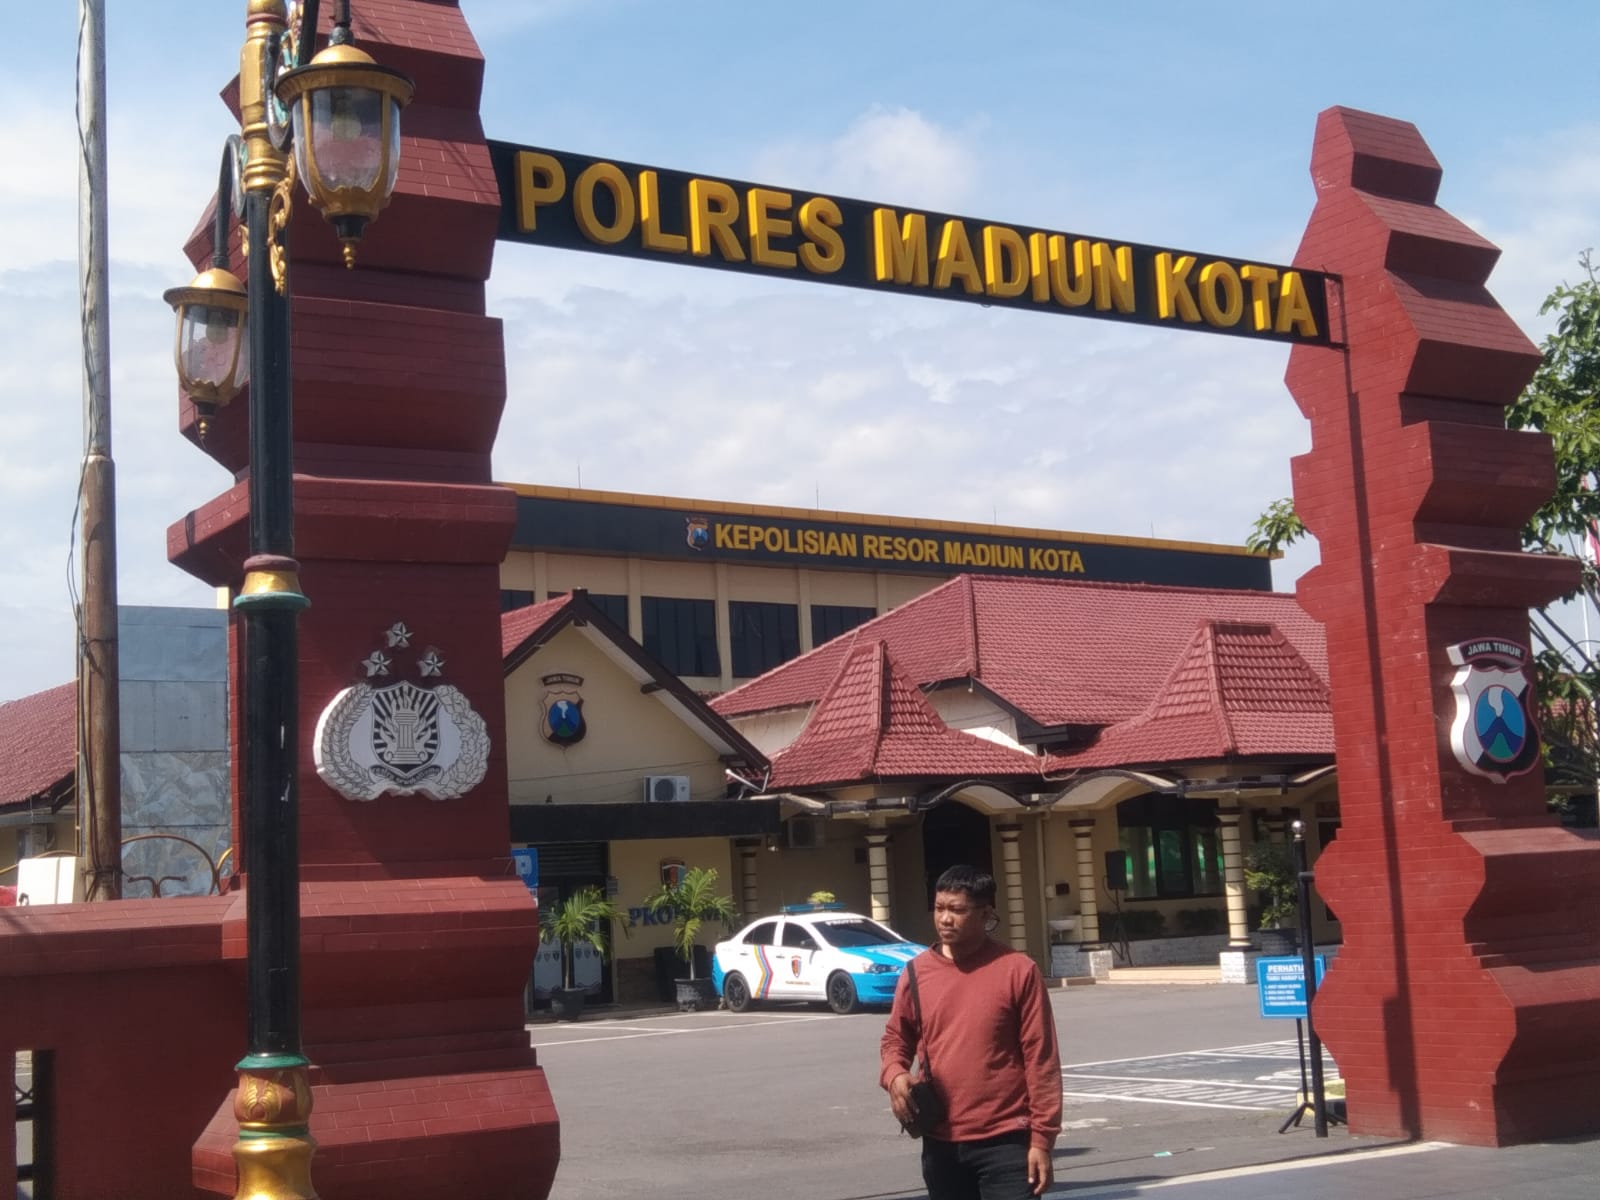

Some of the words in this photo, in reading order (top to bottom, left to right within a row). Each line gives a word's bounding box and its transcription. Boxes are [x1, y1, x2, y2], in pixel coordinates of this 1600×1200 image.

[514, 150, 845, 274] POLRES
[873, 207, 1135, 313] MADIUN
[1154, 252, 1318, 337] KOTA
[715, 522, 859, 557] KEPOLISIAN
[863, 533, 942, 563] RESOR
[944, 543, 1027, 569] MADIUN
[1029, 547, 1085, 573] KOTA
[1467, 642, 1492, 655] JAWA
[1493, 642, 1521, 658] TIMUR
[1267, 964, 1305, 973] PERHATIA
